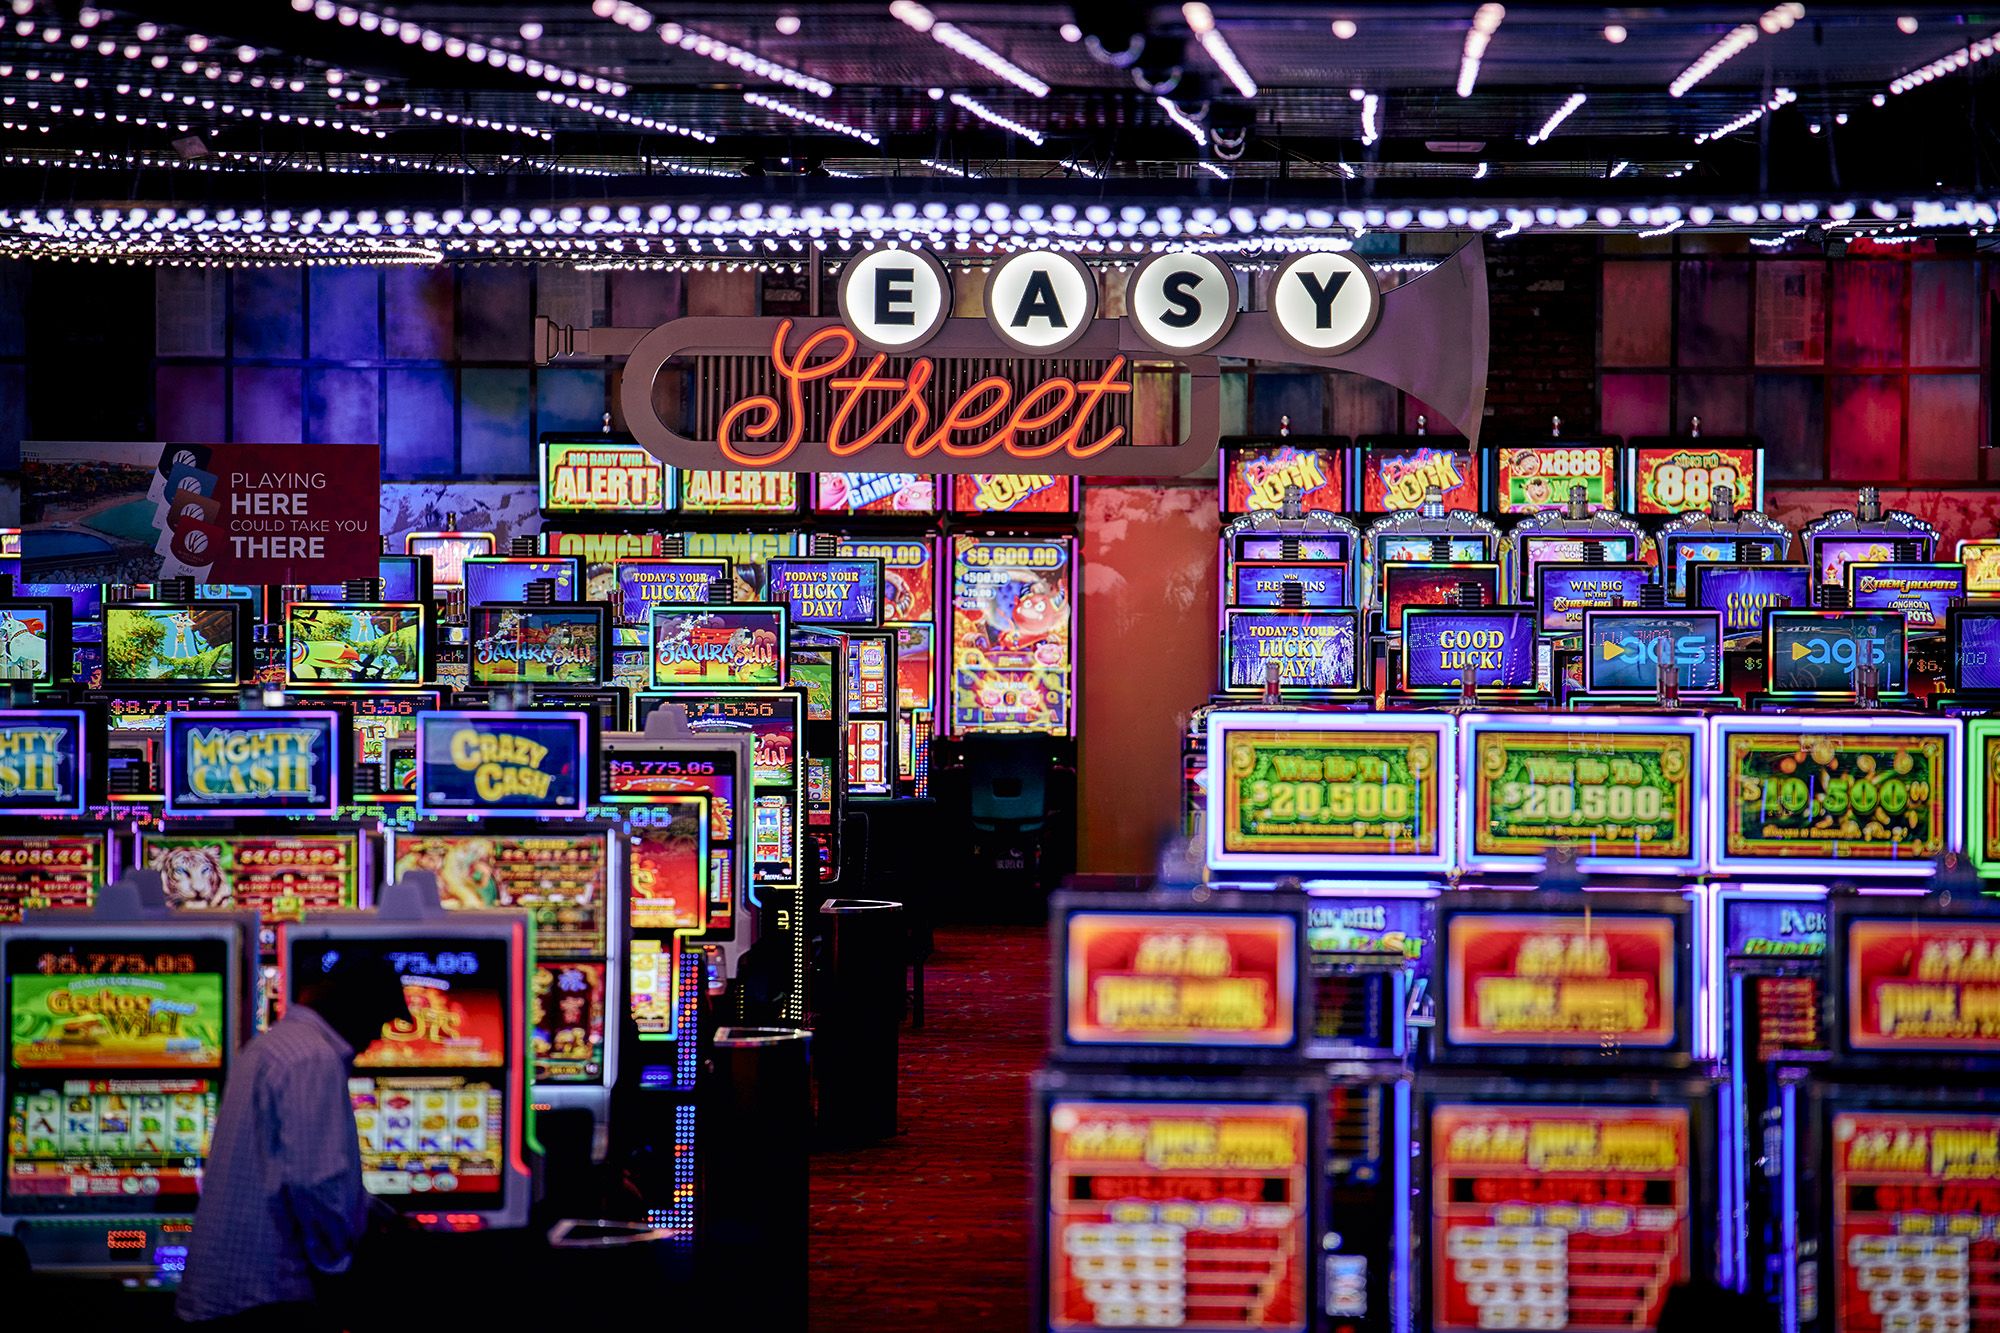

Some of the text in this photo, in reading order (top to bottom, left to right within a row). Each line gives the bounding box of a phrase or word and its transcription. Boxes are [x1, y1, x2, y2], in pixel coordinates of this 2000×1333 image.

[875, 268, 1352, 329] EASY
[717, 319, 1132, 467] Street
[568, 453, 643, 466] BIG BABY WIN
[231, 472, 326, 489] PLAYING
[554, 467, 657, 501] ALERT!
[690, 471, 790, 502] ALERT!
[1656, 464, 1736, 506] 888
[231, 493, 308, 515] HERE
[230, 520, 368, 532] COULD TAKE YOU
[230, 536, 325, 558] THERE
[967, 547, 1057, 566] $6,600.00
[633, 573, 708, 583] TODAY'S YOUR
[785, 572, 859, 582] TODAY'S YOUR
[1570, 581, 1622, 591] WIN BIG
[641, 585, 700, 601] LUCKY
[793, 584, 850, 600] LUCKY
[1256, 581, 1286, 592] FRE
[1902, 580, 1958, 593] JACKPOTS
[802, 601, 842, 617] DAY!
[1888, 600, 1931, 611] LONGHORN
[1566, 613, 1582, 621] PIC
[1250, 626, 1336, 637] TODAY'S YOUR
[1440, 630, 1504, 649] GOOD
[478, 642, 553, 664] SAKURA
[660, 642, 773, 666] SAKURA SUN
[1258, 640, 1326, 658] LUCKY
[1441, 651, 1503, 669] LUCK!
[193, 730, 312, 764] MIGHTY
[451, 729, 548, 770] CRAZY
[193, 756, 310, 794] CASH
[610, 761, 715, 776] $6,775.06
[475, 763, 550, 801] CASH
[1503, 783, 1662, 824] $20,500
